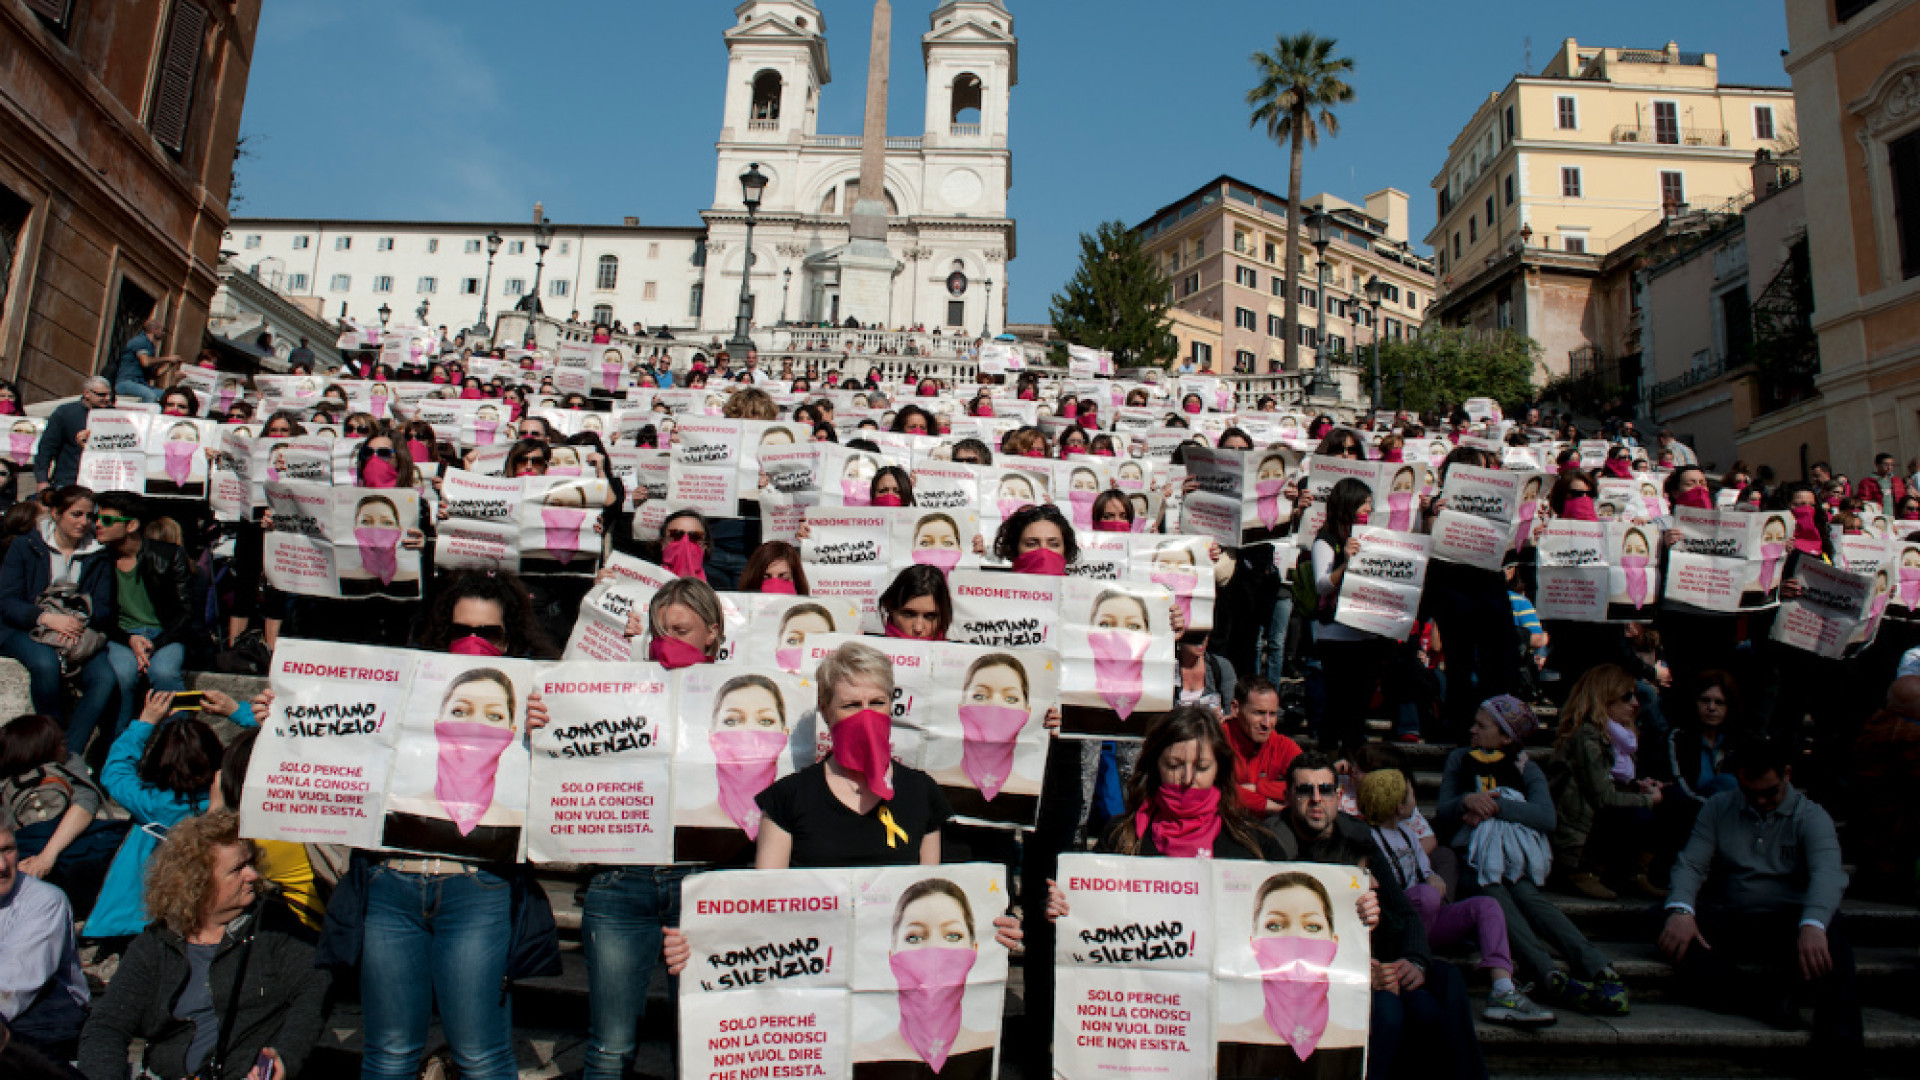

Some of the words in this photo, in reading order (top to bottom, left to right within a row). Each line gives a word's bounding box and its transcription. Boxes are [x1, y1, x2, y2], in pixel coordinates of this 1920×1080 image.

[808, 518, 884, 526] ENDOMETRIOSI
[958, 585, 1052, 601] ENDOMETRIOSI
[282, 662, 399, 681] ENDOMETRIOSI
[545, 682, 664, 694] ENDOMETRIOSI
[280, 761, 311, 773] SOLO
[267, 775, 292, 785] NON
[296, 778, 311, 787] LA
[314, 778, 370, 792] CONOSCI
[561, 782, 593, 792] SOLO
[597, 781, 644, 792] PERCHÉ
[267, 788, 294, 799] NON
[298, 790, 332, 802] VUOL
[335, 793, 363, 804] DIRE
[551, 797, 578, 806] NON
[581, 796, 595, 806] LA
[599, 796, 653, 806] CONOSCI
[262, 802, 286, 813] CHE
[289, 804, 317, 815] NON
[321, 805, 368, 818] ESISTA.
[555, 810, 582, 821] NON
[586, 810, 618, 820] VUOL
[622, 809, 650, 820] DIRE
[550, 824, 574, 834] CHE
[578, 824, 604, 834] NON
[608, 823, 653, 834] ESISTA.
[1069, 877, 1198, 895] ENDOMETRIOSI
[697, 896, 838, 915] ENDOMETRIOSI
[1088, 989, 1123, 1001] SOLO
[1077, 1005, 1106, 1016] NON
[1110, 1007, 1127, 1018] LA
[1130, 1007, 1191, 1021] CONOSCI
[719, 1017, 757, 1032] SOLO
[760, 1012, 816, 1027] PERCHÉ
[1081, 1020, 1112, 1032] NON
[1115, 1022, 1152, 1034] VUOL
[1154, 1024, 1186, 1036] DIRE
[708, 1036, 740, 1050] NON
[744, 1034, 760, 1046] LA
[763, 1032, 827, 1044] CONOSCI
[1077, 1036, 1104, 1047] CHE
[1107, 1037, 1136, 1049] NON
[1140, 1038, 1190, 1052] ESISTA.
[714, 1053, 745, 1067] NON
[749, 1049, 785, 1063] VUOL
[789, 1047, 823, 1060] DIRE
[709, 1070, 737, 1080] CHE
[741, 1066, 769, 1080] NON
[773, 1064, 826, 1077] ESISTA.
